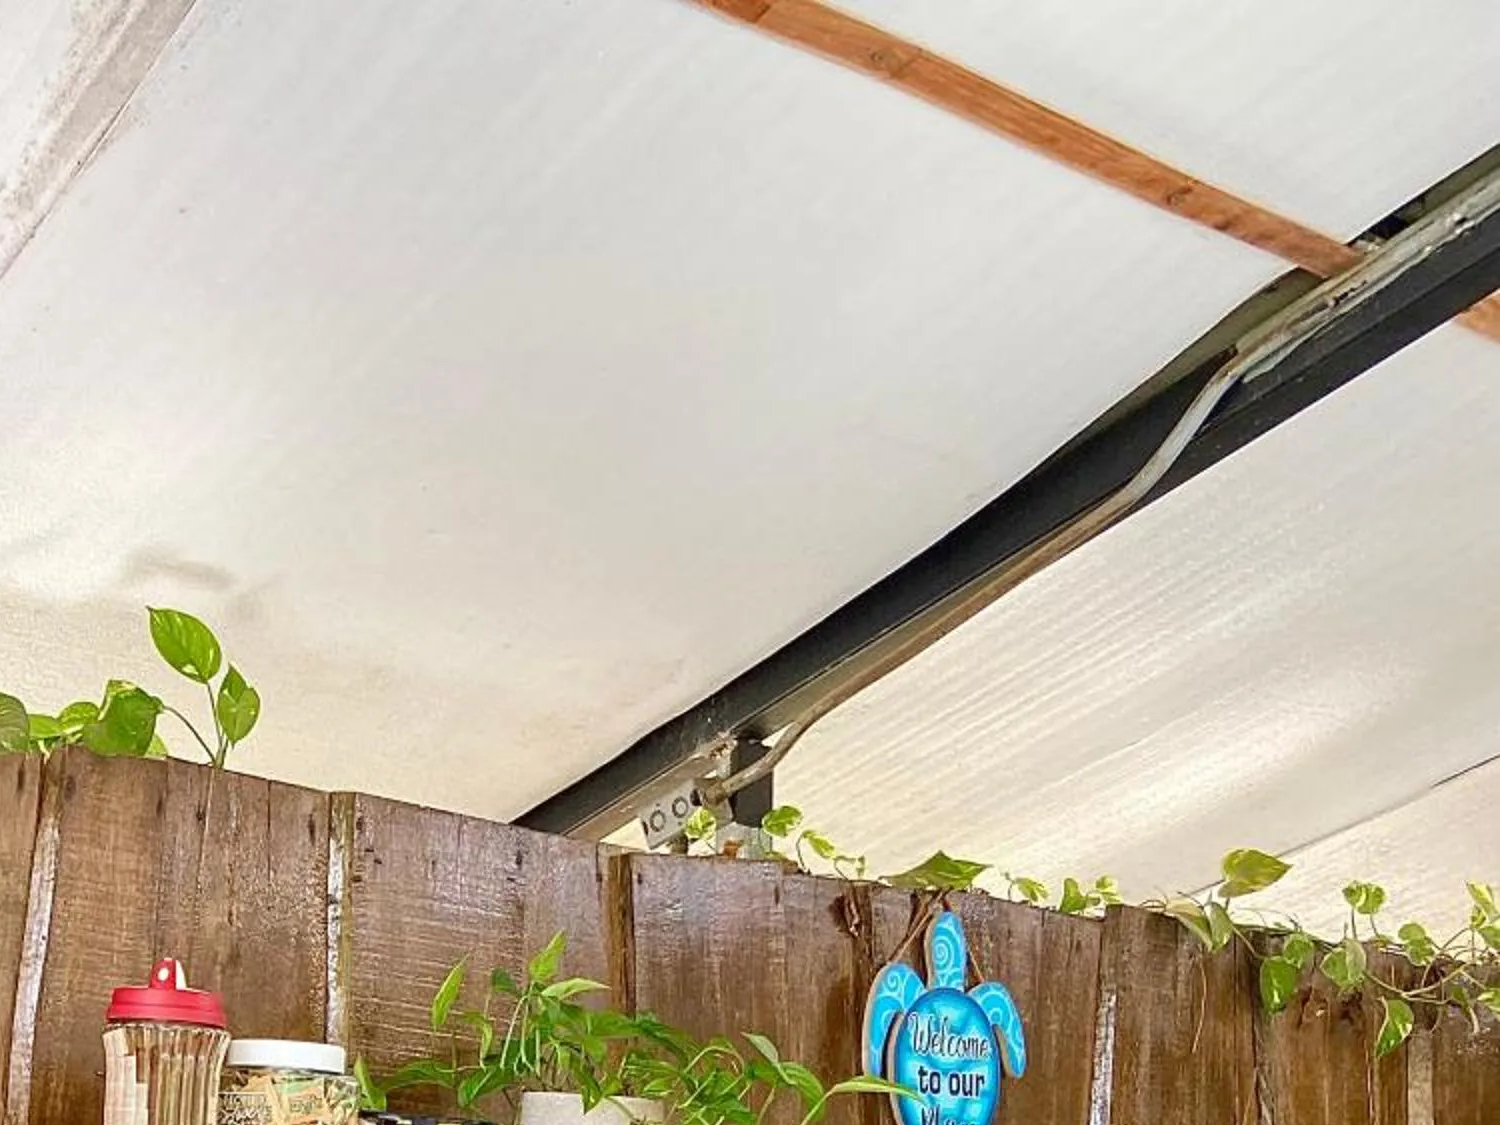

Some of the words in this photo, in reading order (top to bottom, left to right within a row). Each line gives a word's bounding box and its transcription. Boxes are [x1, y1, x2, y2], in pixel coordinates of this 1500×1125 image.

[913, 1013, 990, 1058] Welcome
[917, 1064, 941, 1095] to
[949, 1073, 986, 1098] our
